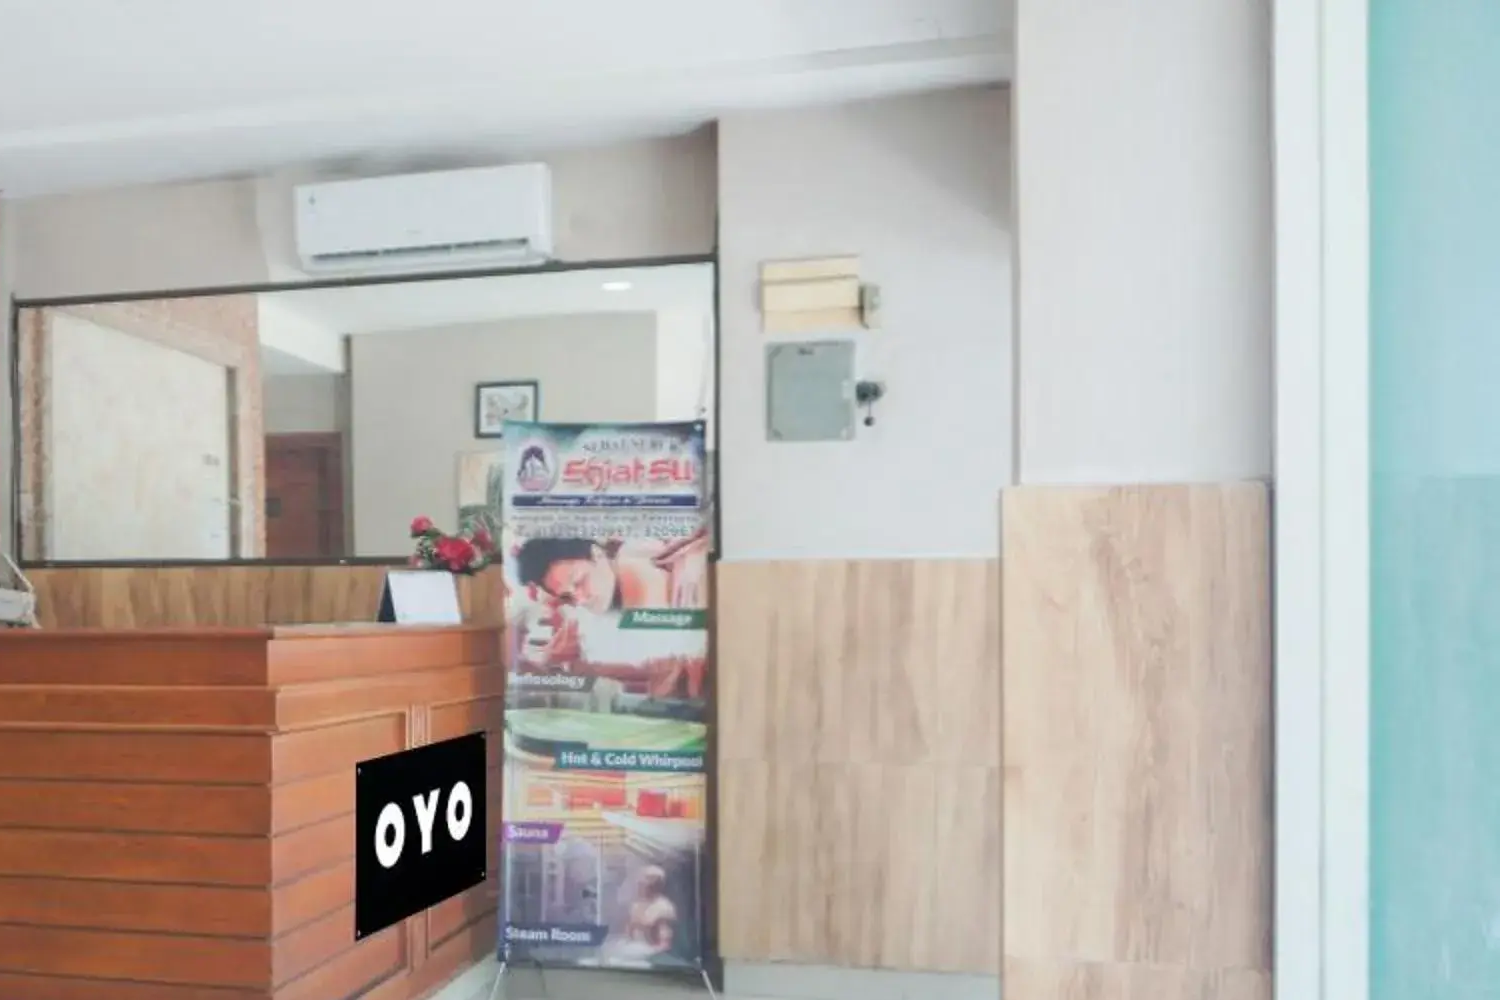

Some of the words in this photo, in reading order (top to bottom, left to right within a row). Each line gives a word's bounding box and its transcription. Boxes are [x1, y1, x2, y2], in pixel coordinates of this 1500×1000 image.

[561, 752, 587, 765] Hot
[591, 753, 602, 765] &
[605, 752, 636, 766] Cold
[375, 781, 473, 868] OYO
[507, 825, 548, 839] Sauna
[505, 926, 548, 940] Steam
[551, 928, 591, 941] Room
